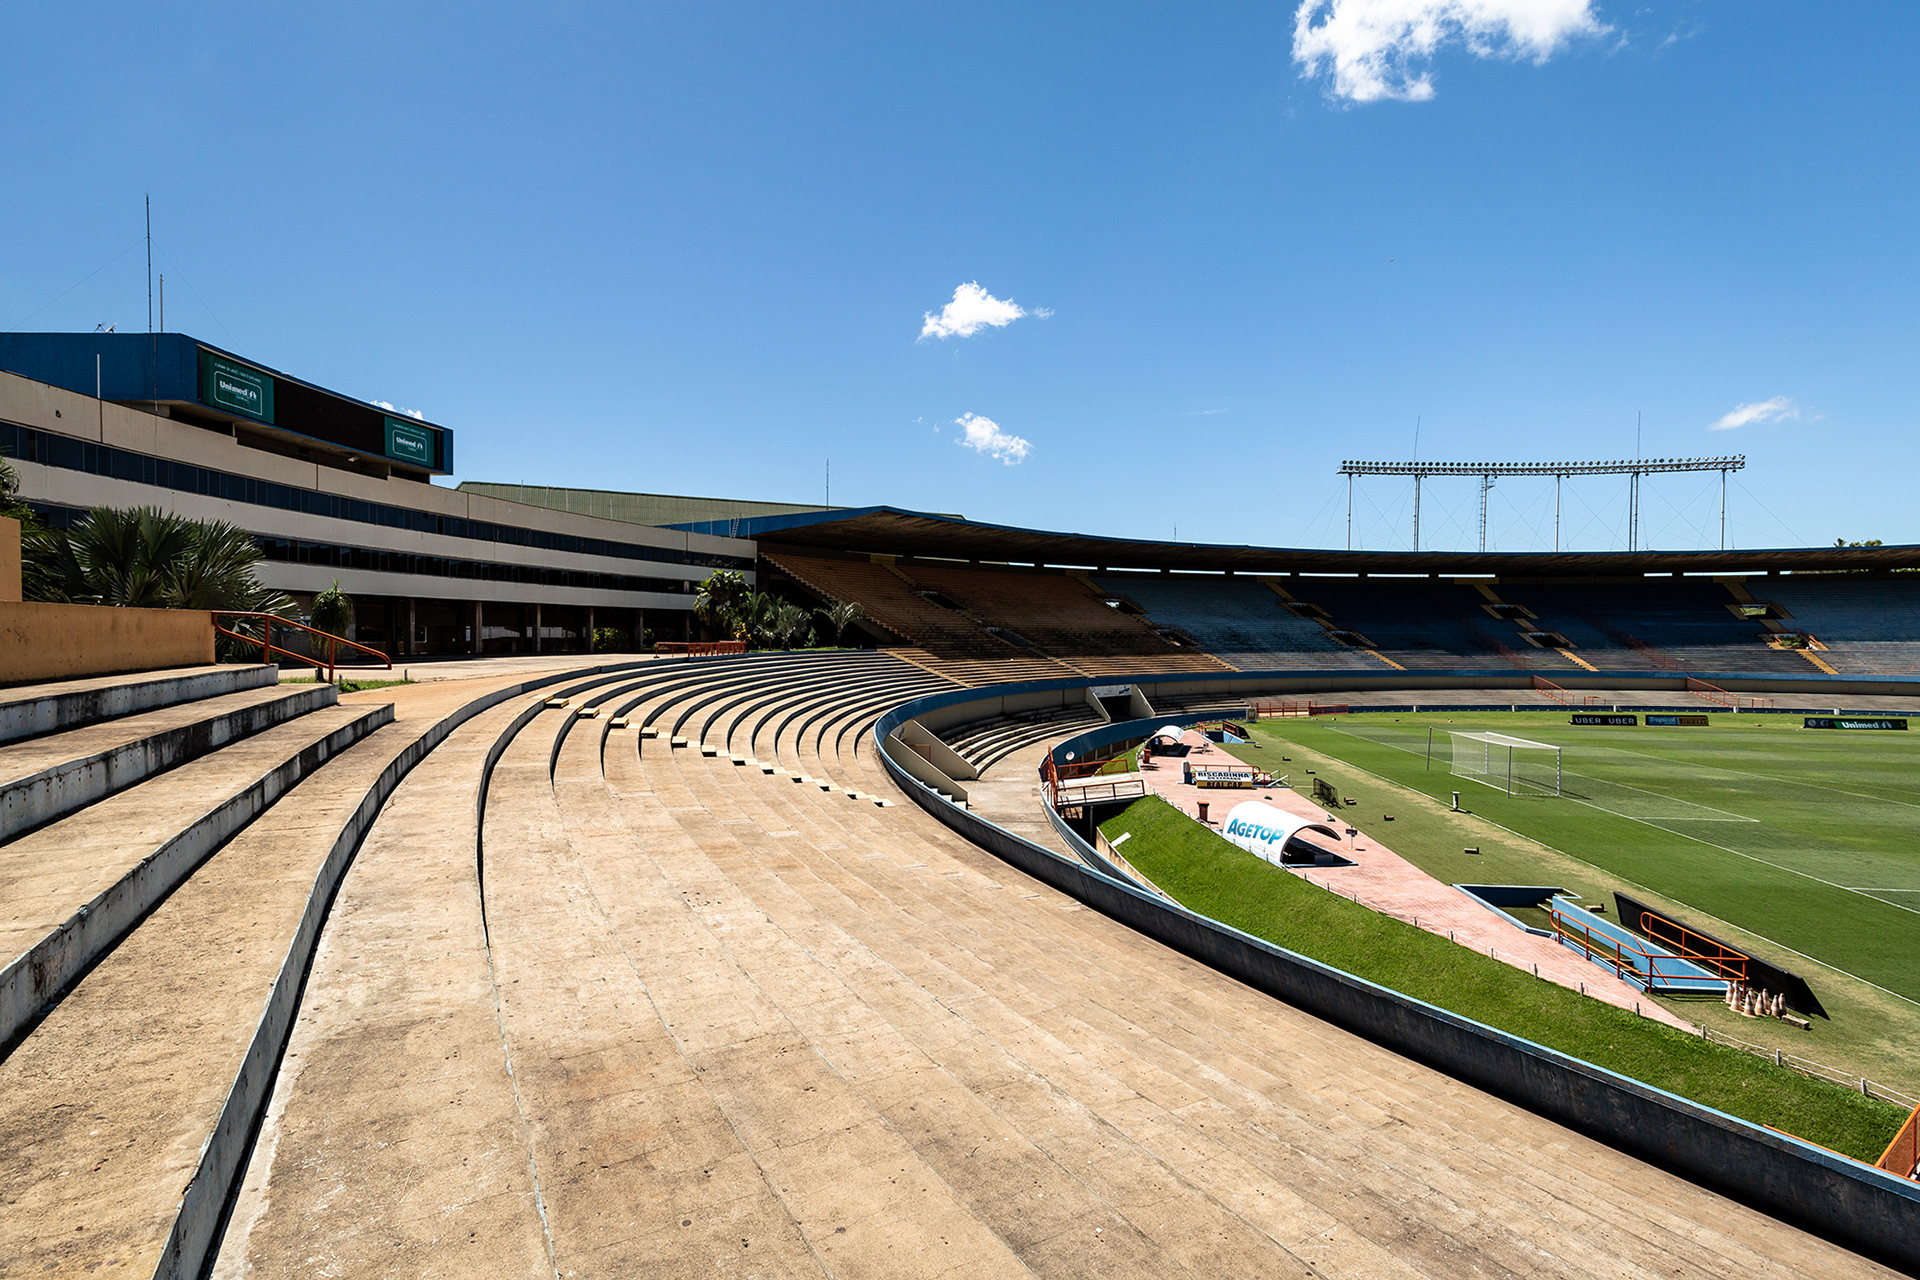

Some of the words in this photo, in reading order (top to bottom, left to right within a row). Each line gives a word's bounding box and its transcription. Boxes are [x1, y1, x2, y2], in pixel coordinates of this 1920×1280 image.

[219, 380, 248, 396] Unimed
[396, 436, 417, 448] Unimed
[1608, 717, 1635, 725] UBER
[1841, 721, 1879, 729] Unimed
[1227, 818, 1285, 845] AGETOP
